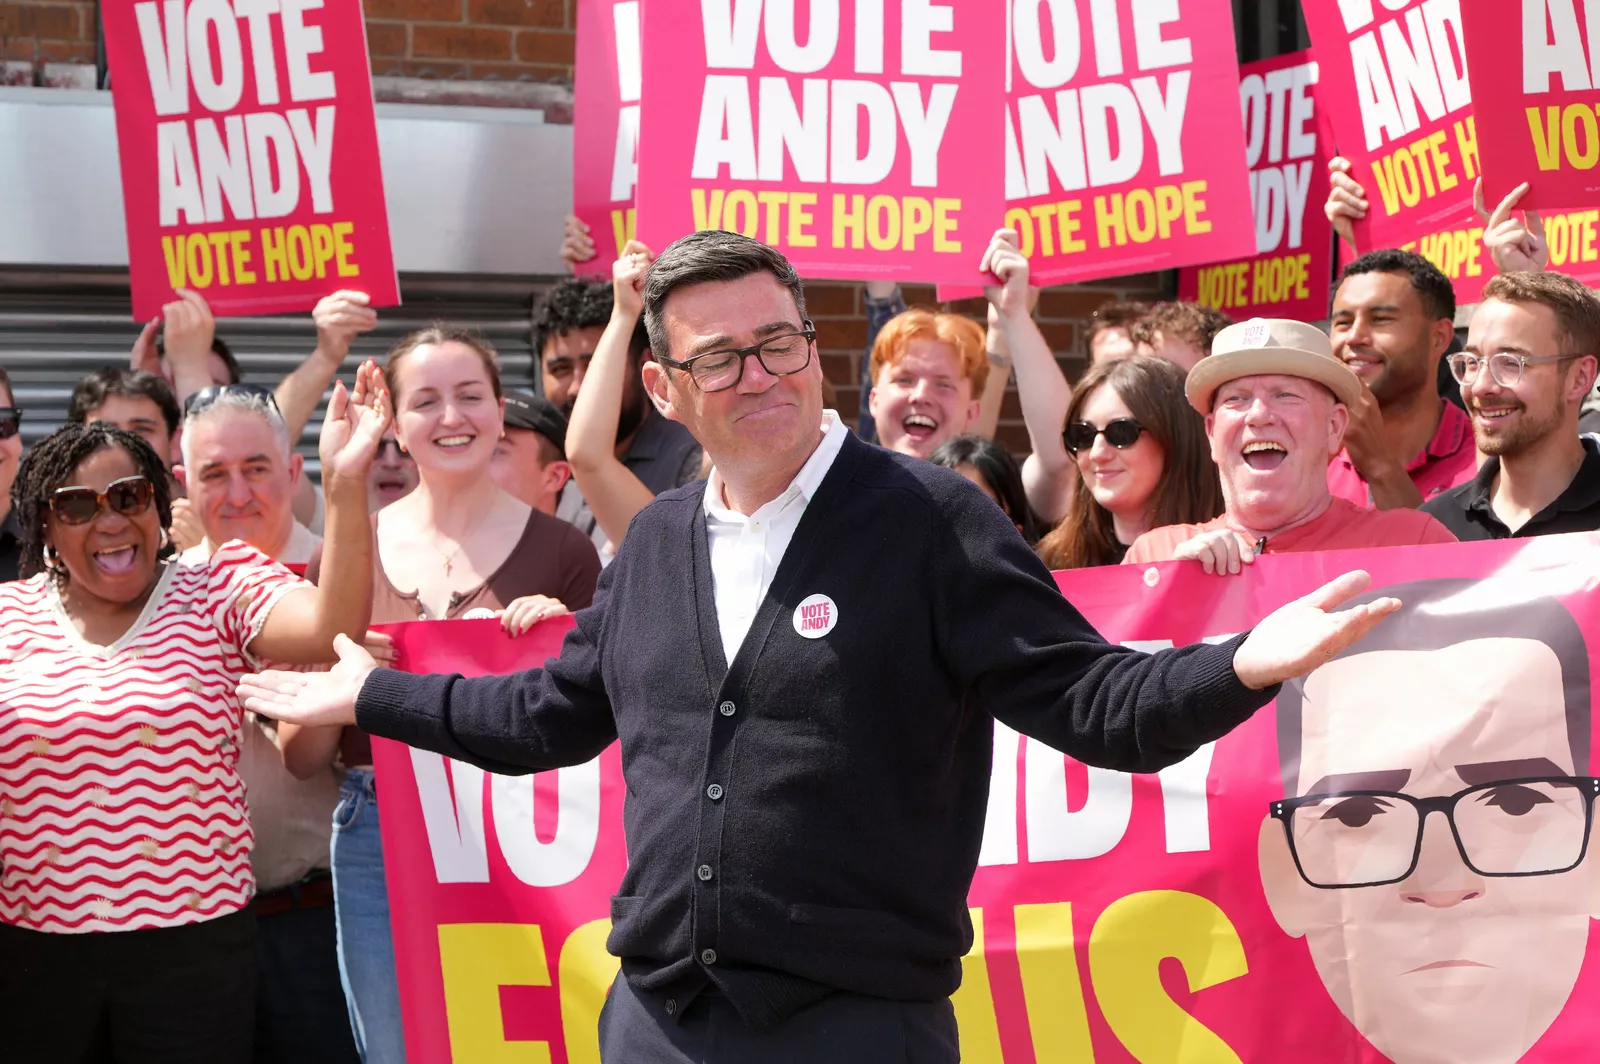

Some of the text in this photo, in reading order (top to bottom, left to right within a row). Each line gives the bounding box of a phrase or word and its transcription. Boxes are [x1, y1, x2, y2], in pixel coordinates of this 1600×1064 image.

[134, 0, 337, 116] VOTE
[1005, 0, 1193, 93] OTE
[1349, 0, 1473, 152] AND
[691, 74, 959, 187] ANDY
[1239, 61, 1320, 170] OTE
[1525, 102, 1600, 171] VO
[157, 105, 336, 227] ANDY
[1249, 160, 1314, 254] DY
[1370, 129, 1458, 217] VOTE
[161, 221, 360, 290] VOTE HOPE
[690, 188, 818, 247] VOTE
[832, 193, 962, 253] HOPE
[1004, 180, 1213, 260] OTE HOPE
[1198, 262, 1250, 311] VOTE
[1252, 253, 1312, 306] HOPE
[801, 601, 830, 618] VOTE
[801, 616, 830, 631] ANDY
[408, 743, 600, 888] VO
